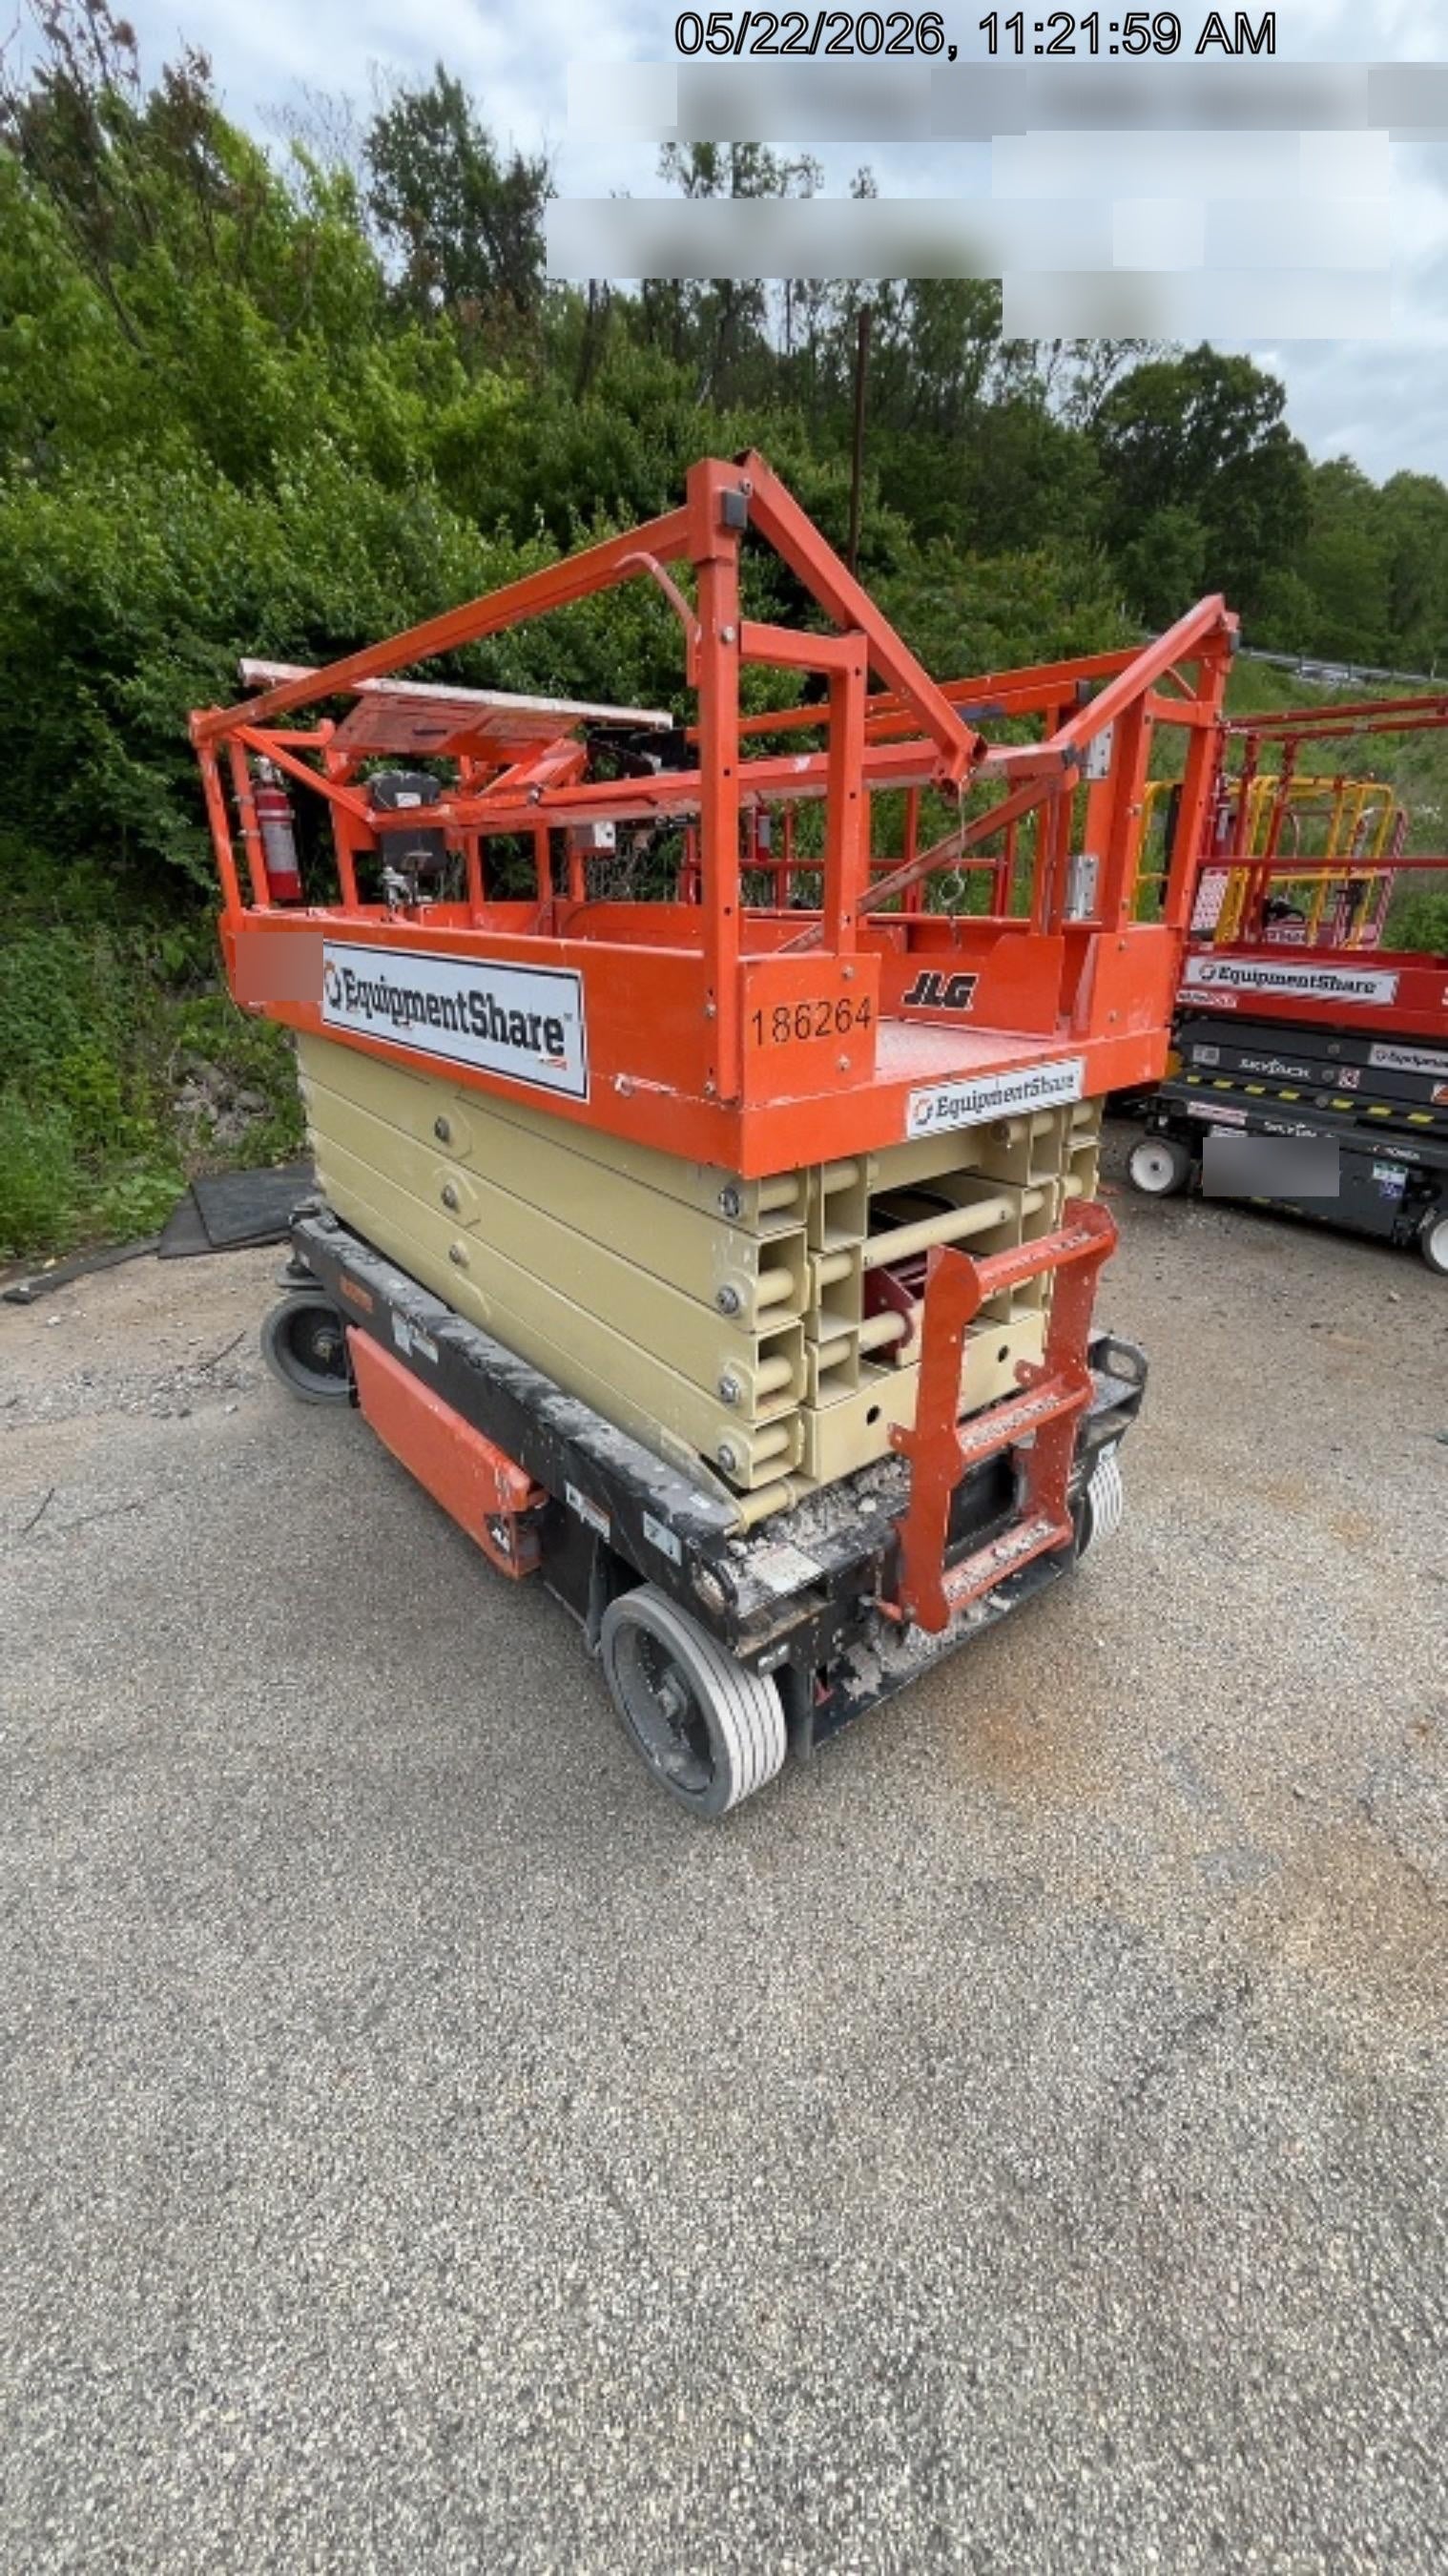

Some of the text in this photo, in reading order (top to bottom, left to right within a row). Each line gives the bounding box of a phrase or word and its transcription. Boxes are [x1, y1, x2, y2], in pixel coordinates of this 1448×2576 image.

[902, 970, 979, 1010] JLG
[1217, 966, 1377, 995] EquipmentShare
[342, 968, 566, 1056] EquipmentShare
[751, 996, 873, 1048] 186264
[935, 1073, 1075, 1121] EquipmentShare
